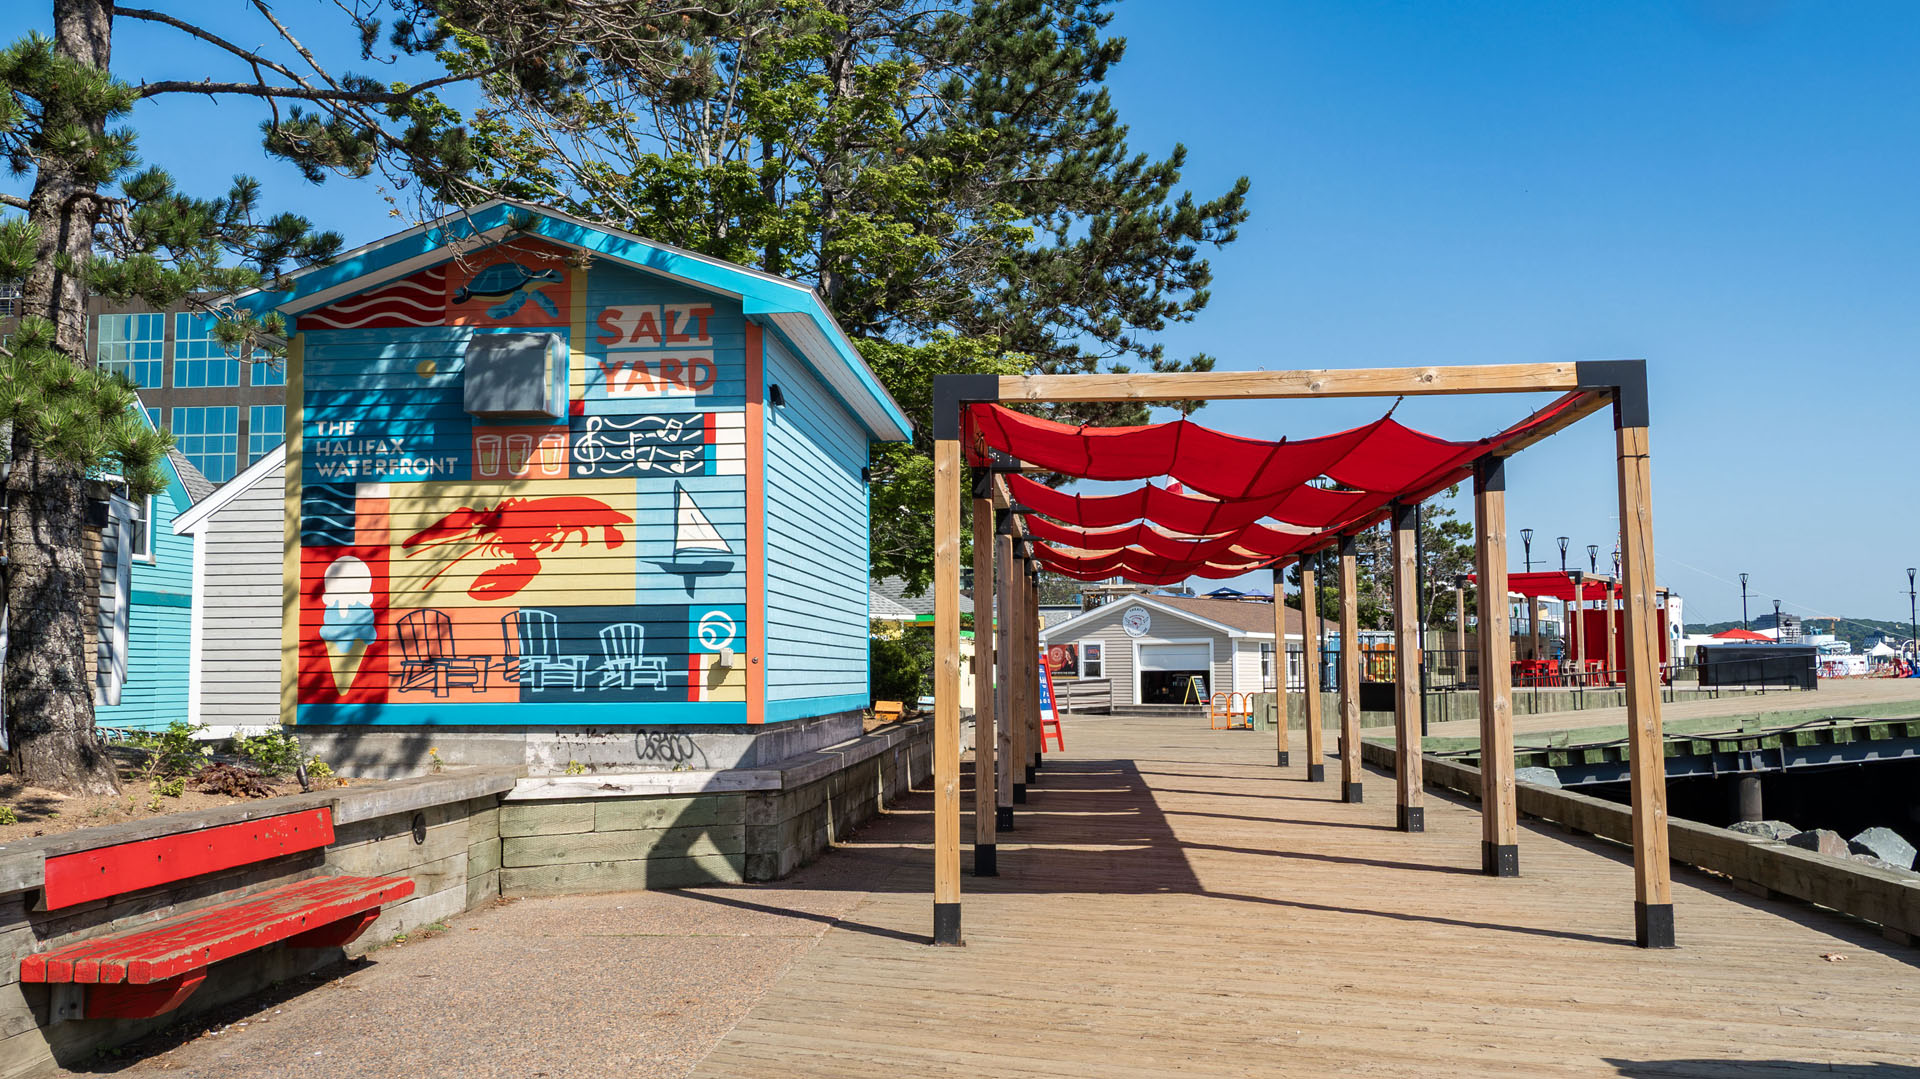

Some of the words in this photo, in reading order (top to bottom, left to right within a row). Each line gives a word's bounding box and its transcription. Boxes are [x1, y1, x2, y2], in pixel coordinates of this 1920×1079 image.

[596, 307, 715, 345] SALT
[597, 357, 718, 392] YARD
[315, 421, 355, 436] THE
[315, 438, 405, 456] HALIFAX
[315, 456, 458, 477] WATERFRONT
